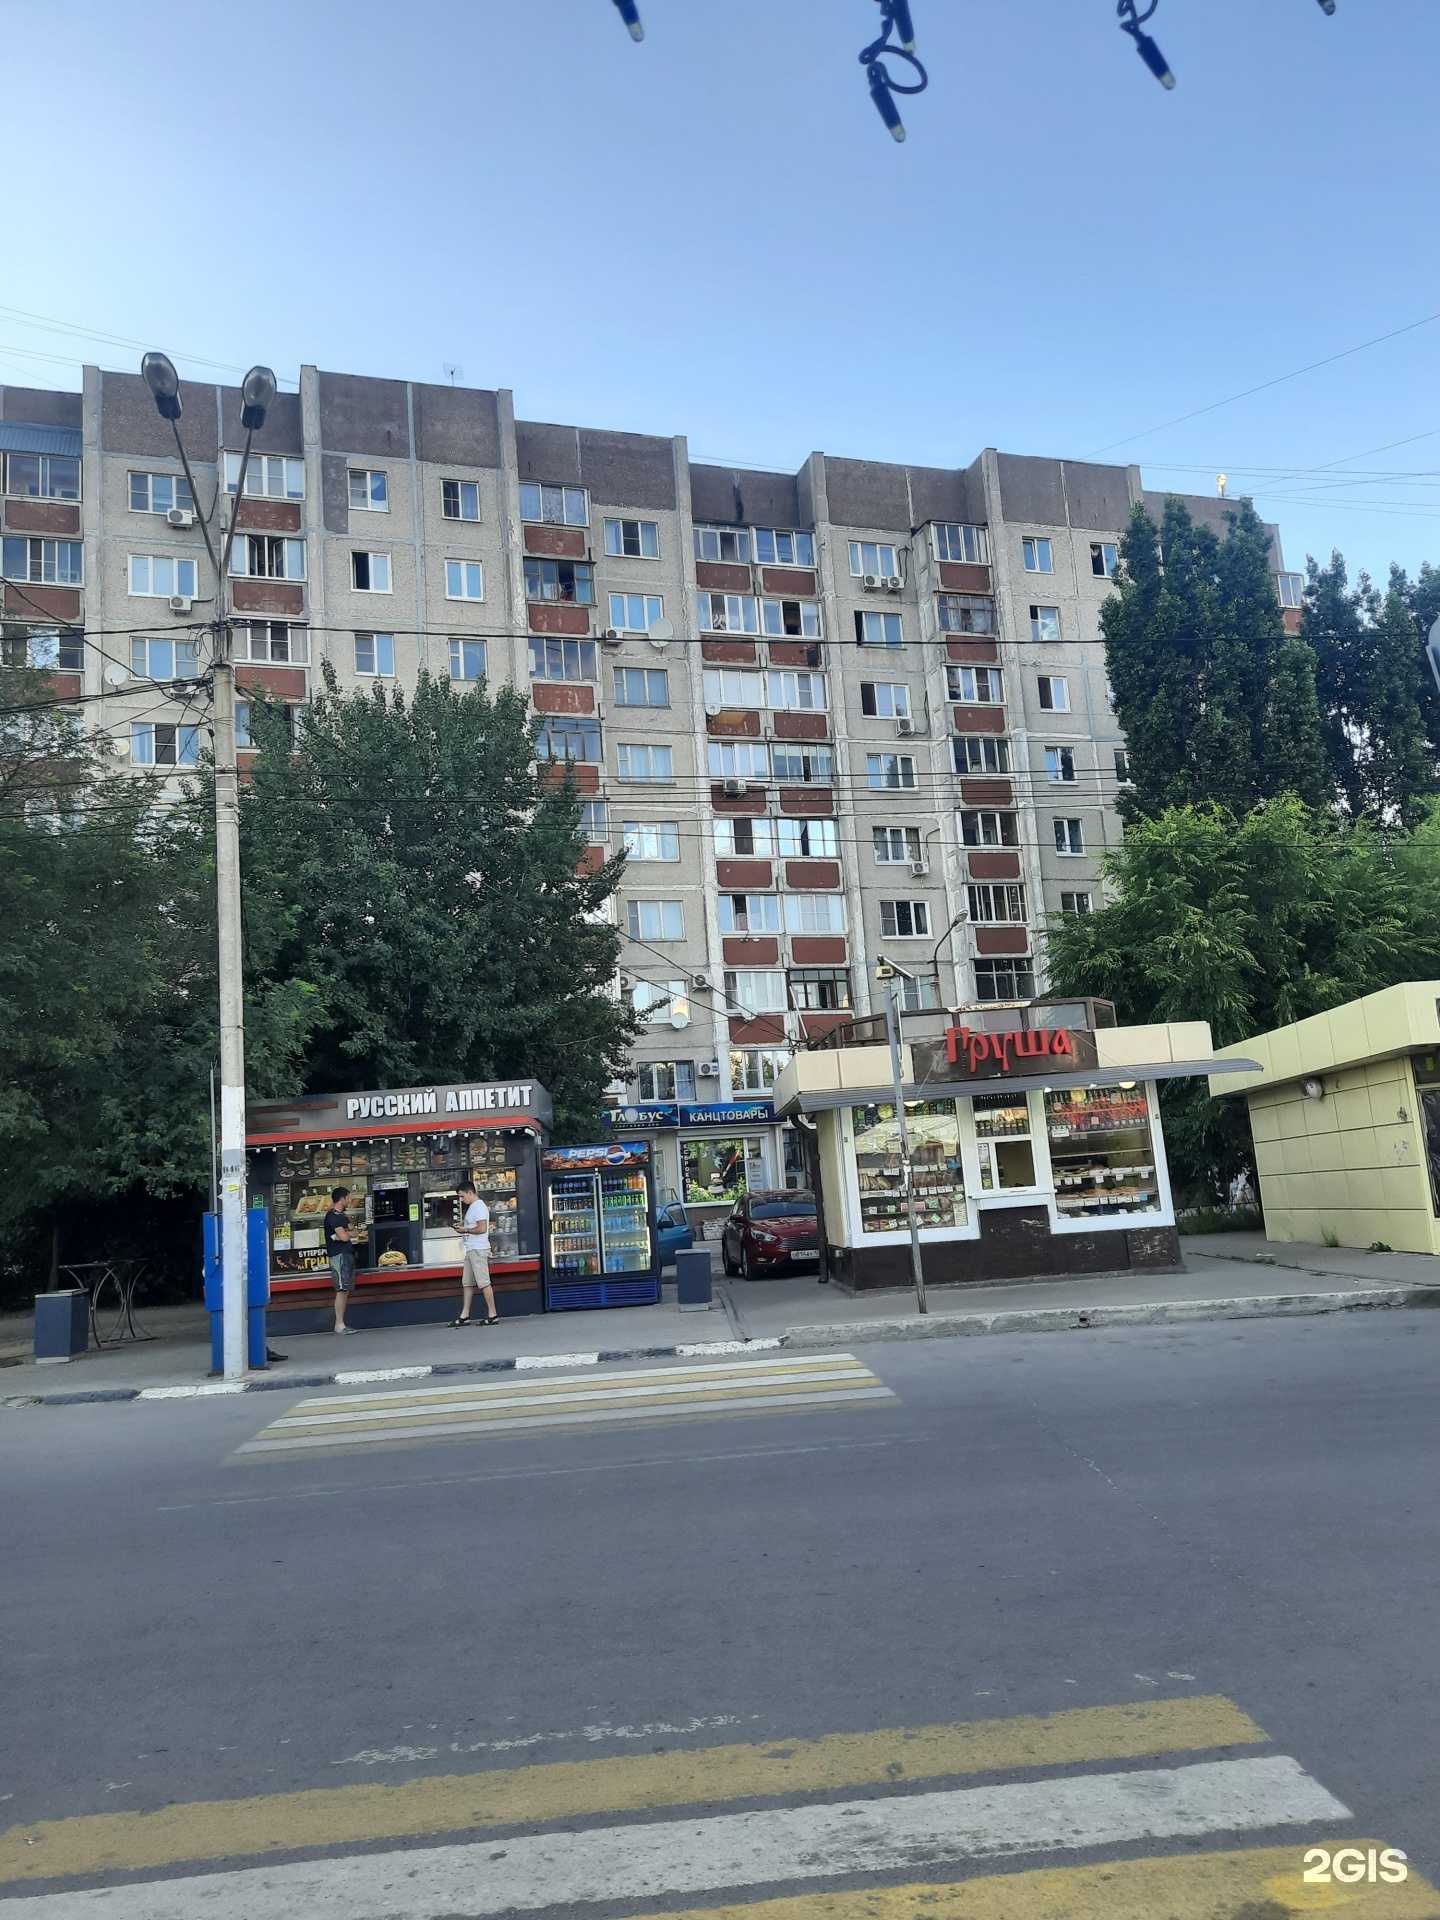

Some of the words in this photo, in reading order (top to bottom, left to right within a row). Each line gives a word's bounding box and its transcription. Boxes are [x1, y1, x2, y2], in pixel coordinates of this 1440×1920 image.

[946, 1026, 1073, 1073] Груша
[347, 1088, 437, 1120] РУССКИЙ
[445, 1085, 533, 1113] АППЕТИТ
[689, 1109, 769, 1123] КАНЦТОВАРЫ
[568, 1147, 608, 1159] PEPSI
